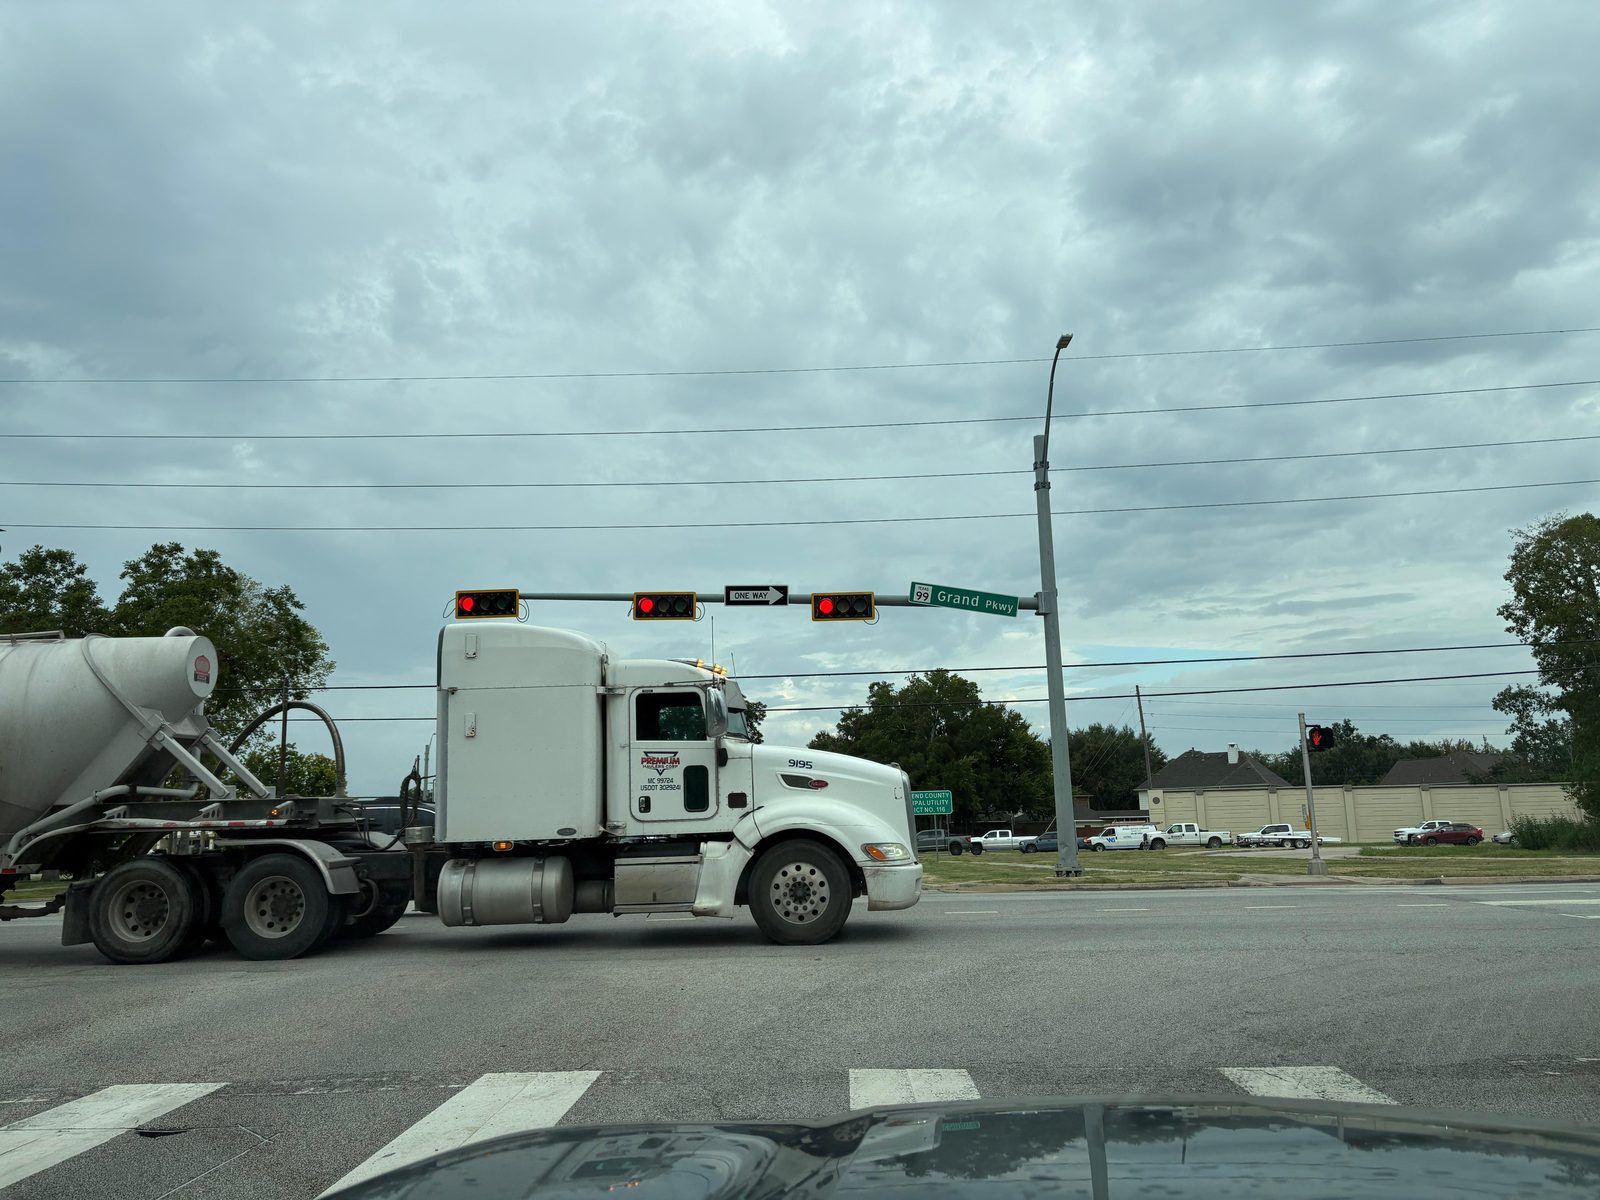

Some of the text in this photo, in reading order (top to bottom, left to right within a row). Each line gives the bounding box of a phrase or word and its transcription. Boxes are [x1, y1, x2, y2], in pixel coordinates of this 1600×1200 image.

[734, 592, 769, 600] ONE WAY
[916, 591, 930, 601] 99
[937, 590, 1014, 614] Grand Pkwy
[640, 757, 681, 765] PREMIUM
[788, 759, 813, 770] 9195
